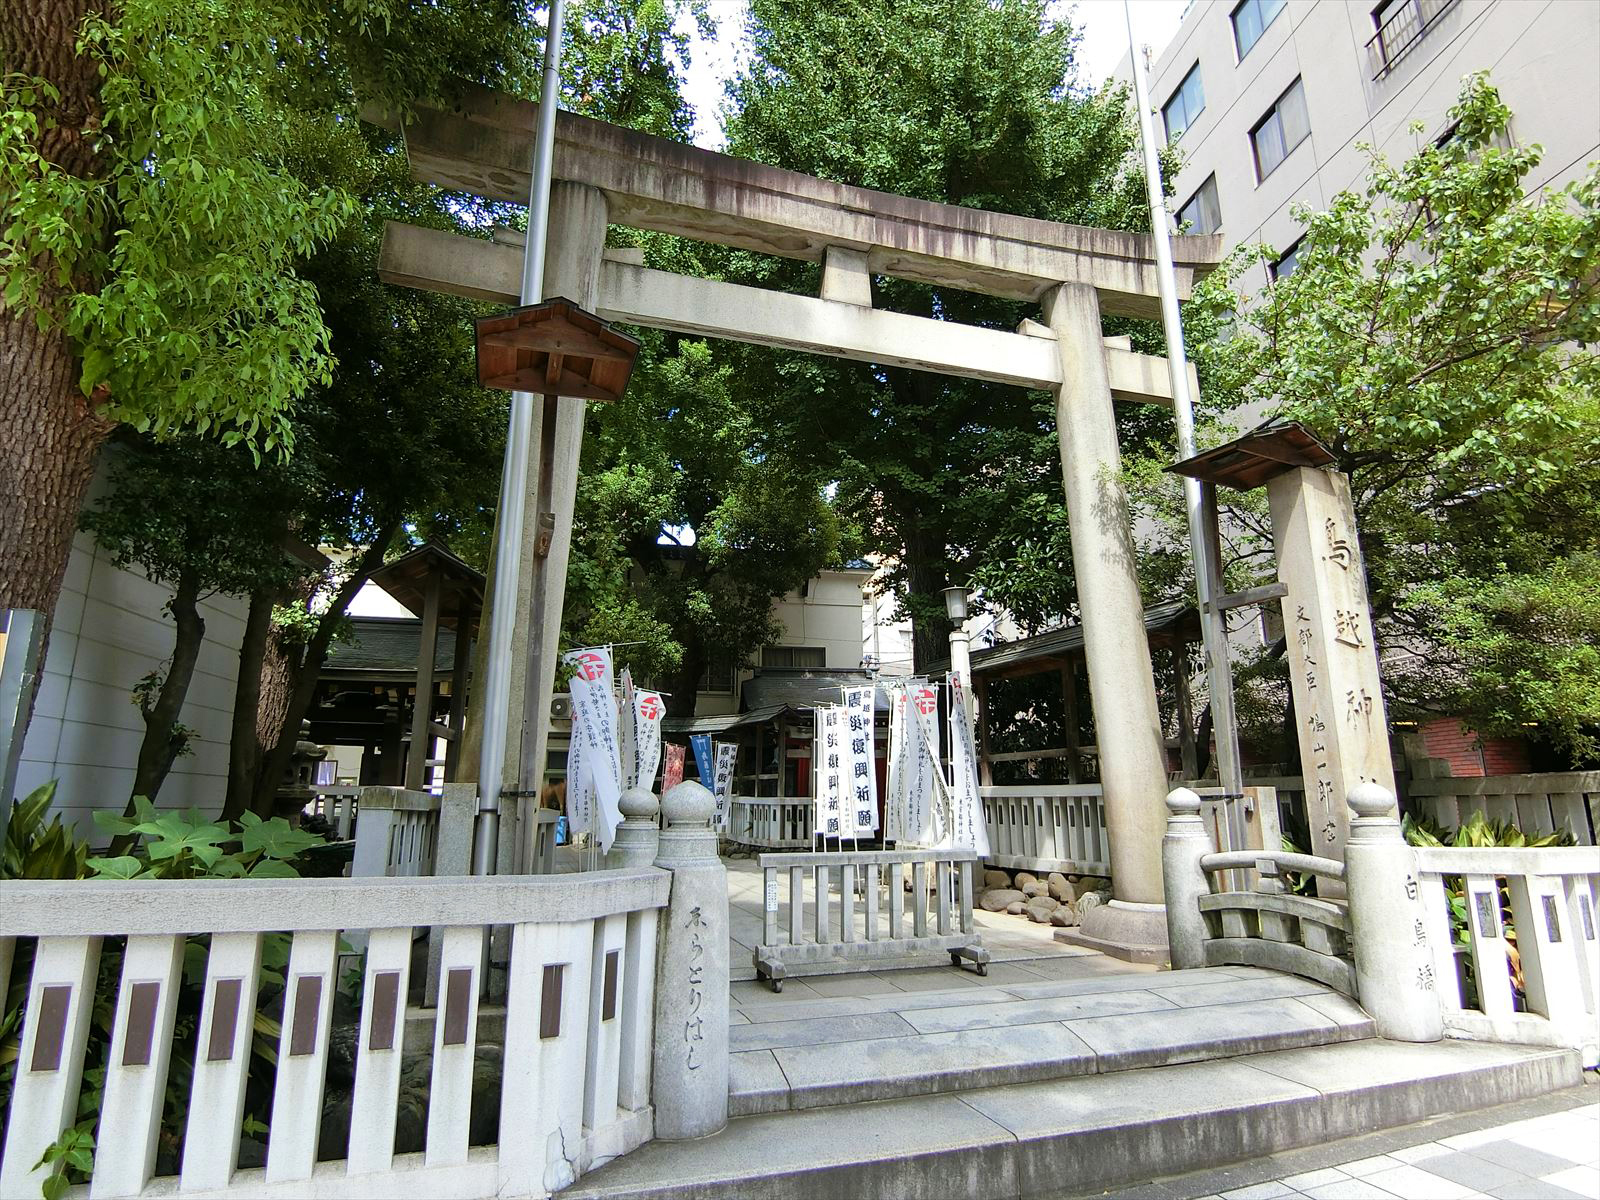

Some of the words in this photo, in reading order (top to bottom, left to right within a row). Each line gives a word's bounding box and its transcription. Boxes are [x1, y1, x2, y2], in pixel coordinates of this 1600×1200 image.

[1296, 605, 1318, 692] 文部大臣
[1321, 516, 1377, 784] 鳥越神
[848, 690, 872, 826] 震災復興祈願
